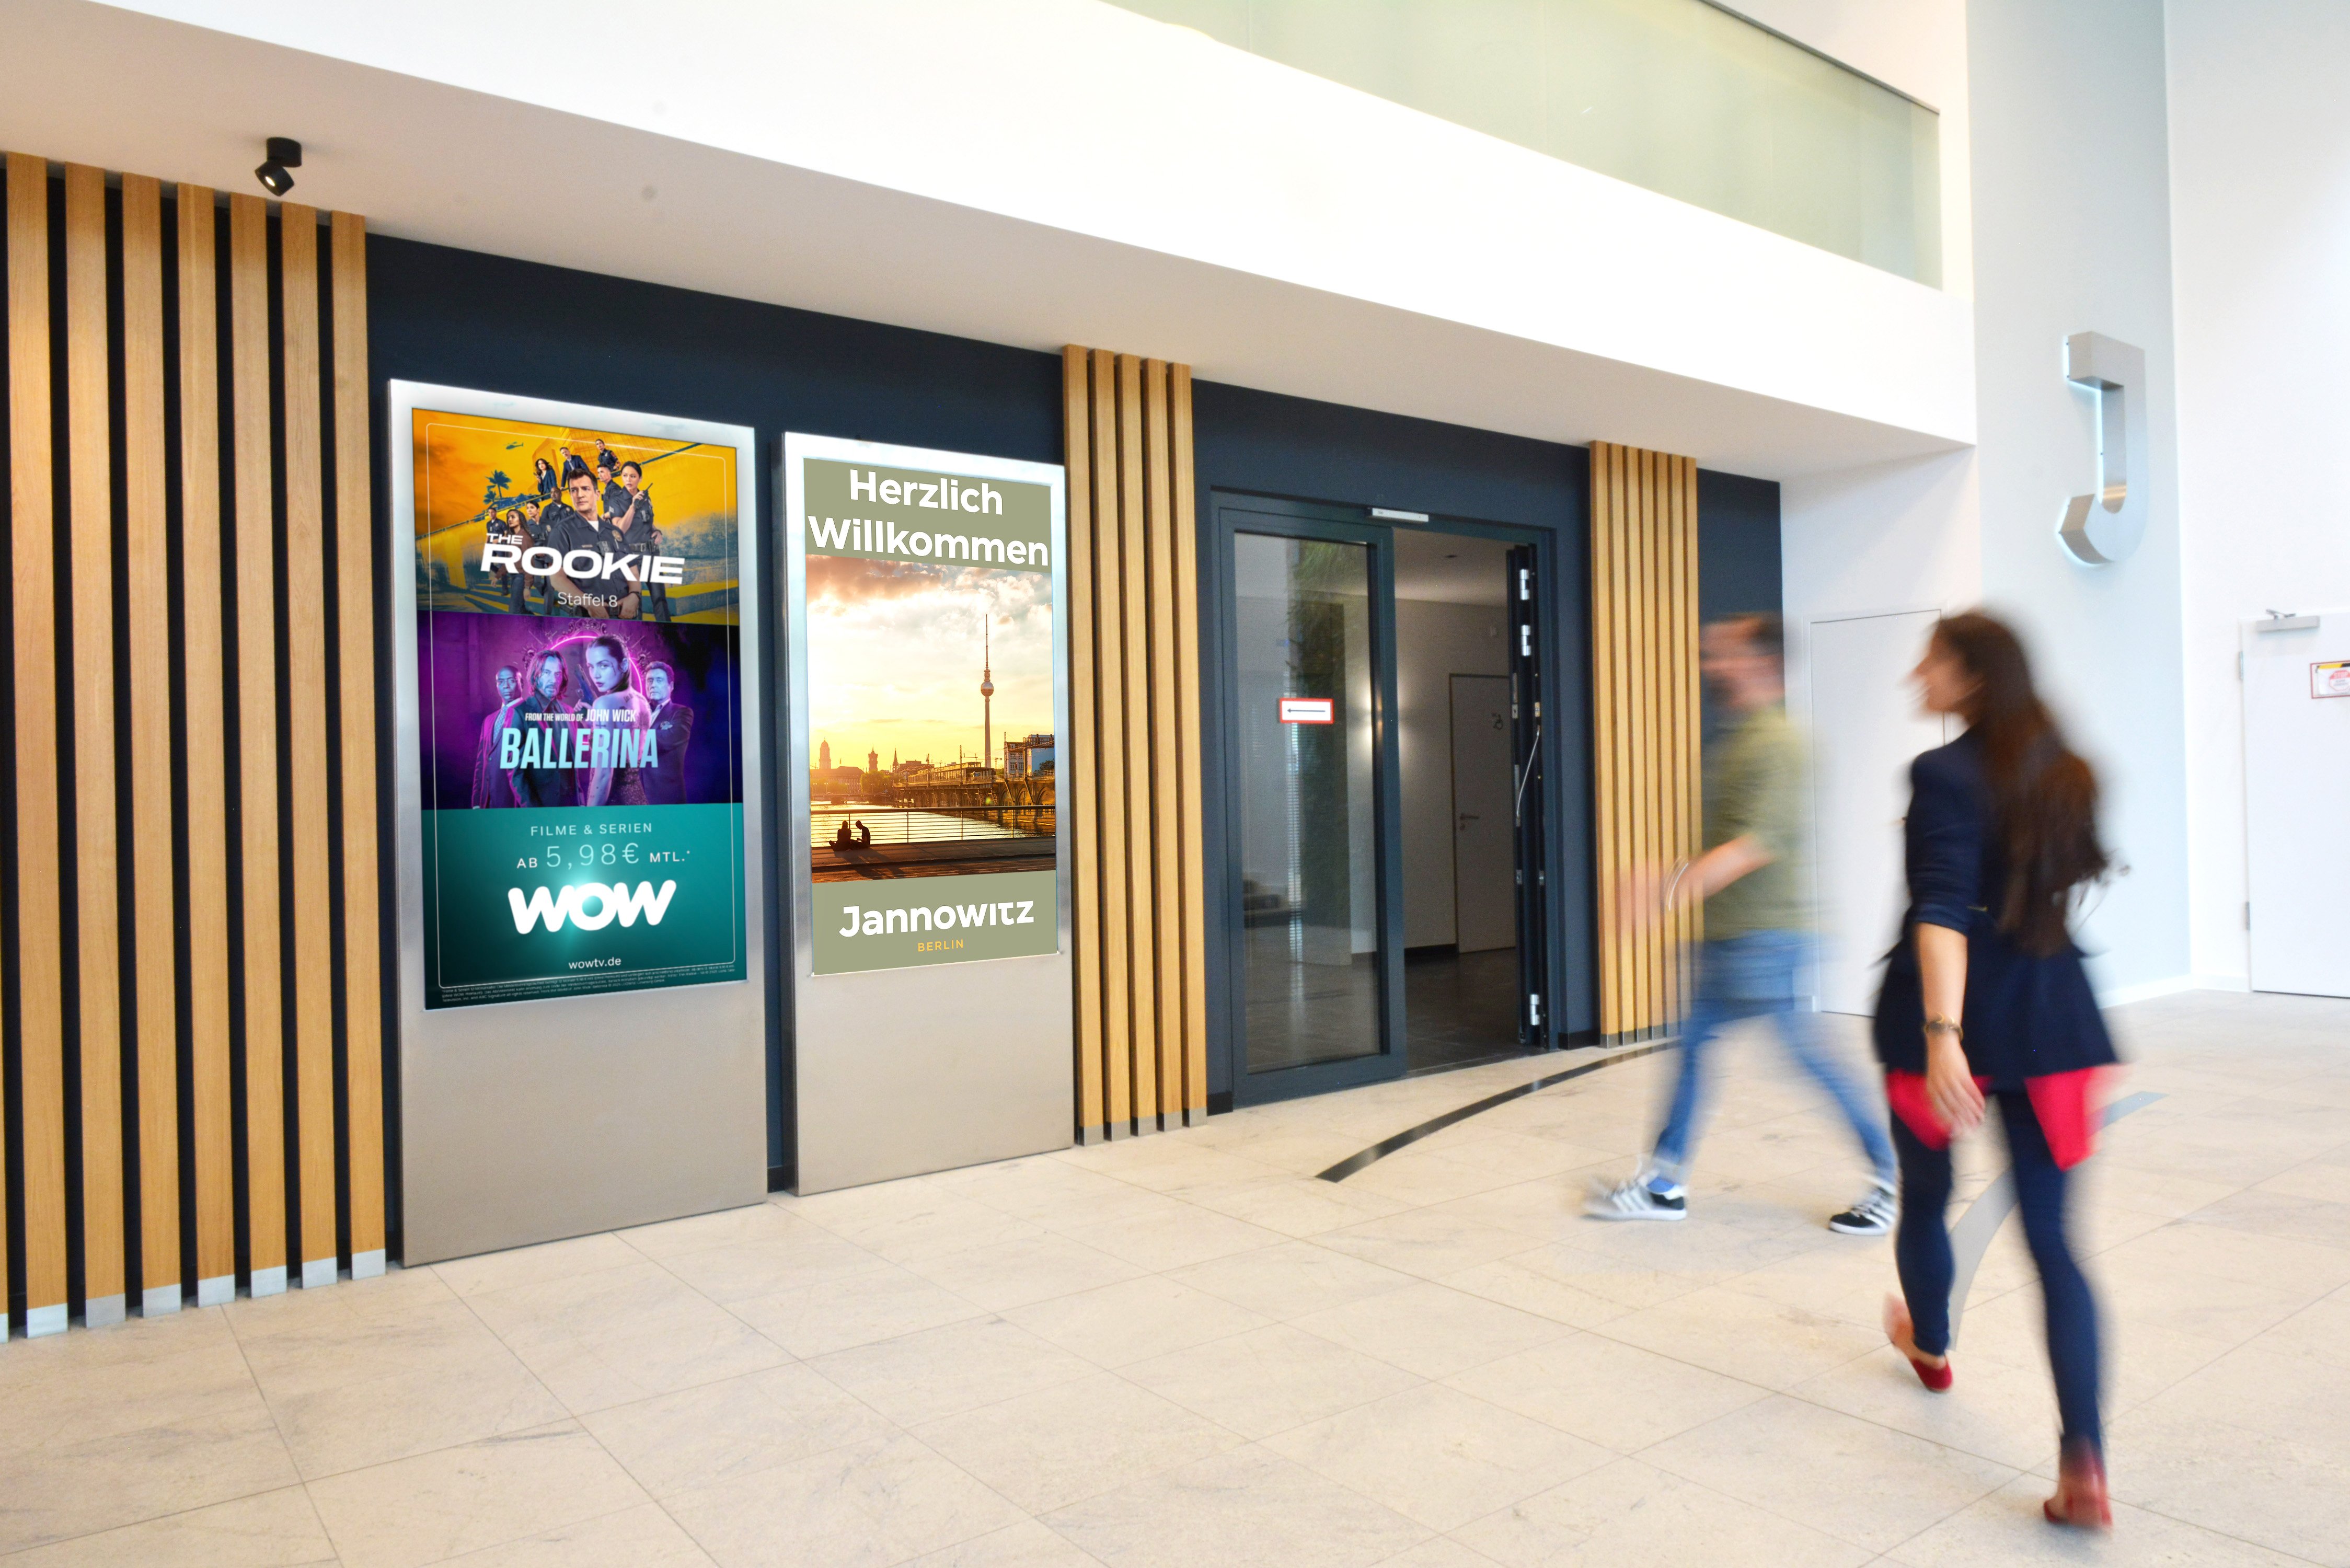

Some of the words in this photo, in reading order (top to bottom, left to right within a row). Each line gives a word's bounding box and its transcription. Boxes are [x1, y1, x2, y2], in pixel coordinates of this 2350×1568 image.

[2057, 330, 2148, 564] J
[850, 469, 1003, 515] Herzlich
[486, 532, 523, 545] THE
[808, 515, 1048, 566] Willkommen
[480, 543, 685, 584] ROOKIE
[557, 592, 604, 607] Staffel
[608, 595, 618, 607] 8
[525, 712, 542, 721] FROM
[543, 713, 554, 721] THE
[555, 713, 575, 721] WORLD
[585, 709, 609, 722] JOHN
[612, 709, 637, 722] WICK
[500, 727, 658, 769] BALLERINA
[531, 825, 577, 836] FILME
[583, 824, 593, 835] &
[600, 823, 652, 834] SERIEN
[516, 857, 538, 869] AB
[546, 842, 639, 870] 5,98€
[508, 880, 677, 935] WOW
[838, 900, 1034, 938] Jannowitz
[917, 939, 964, 952] BERLIN
[568, 956, 622, 970] wowtv.de
